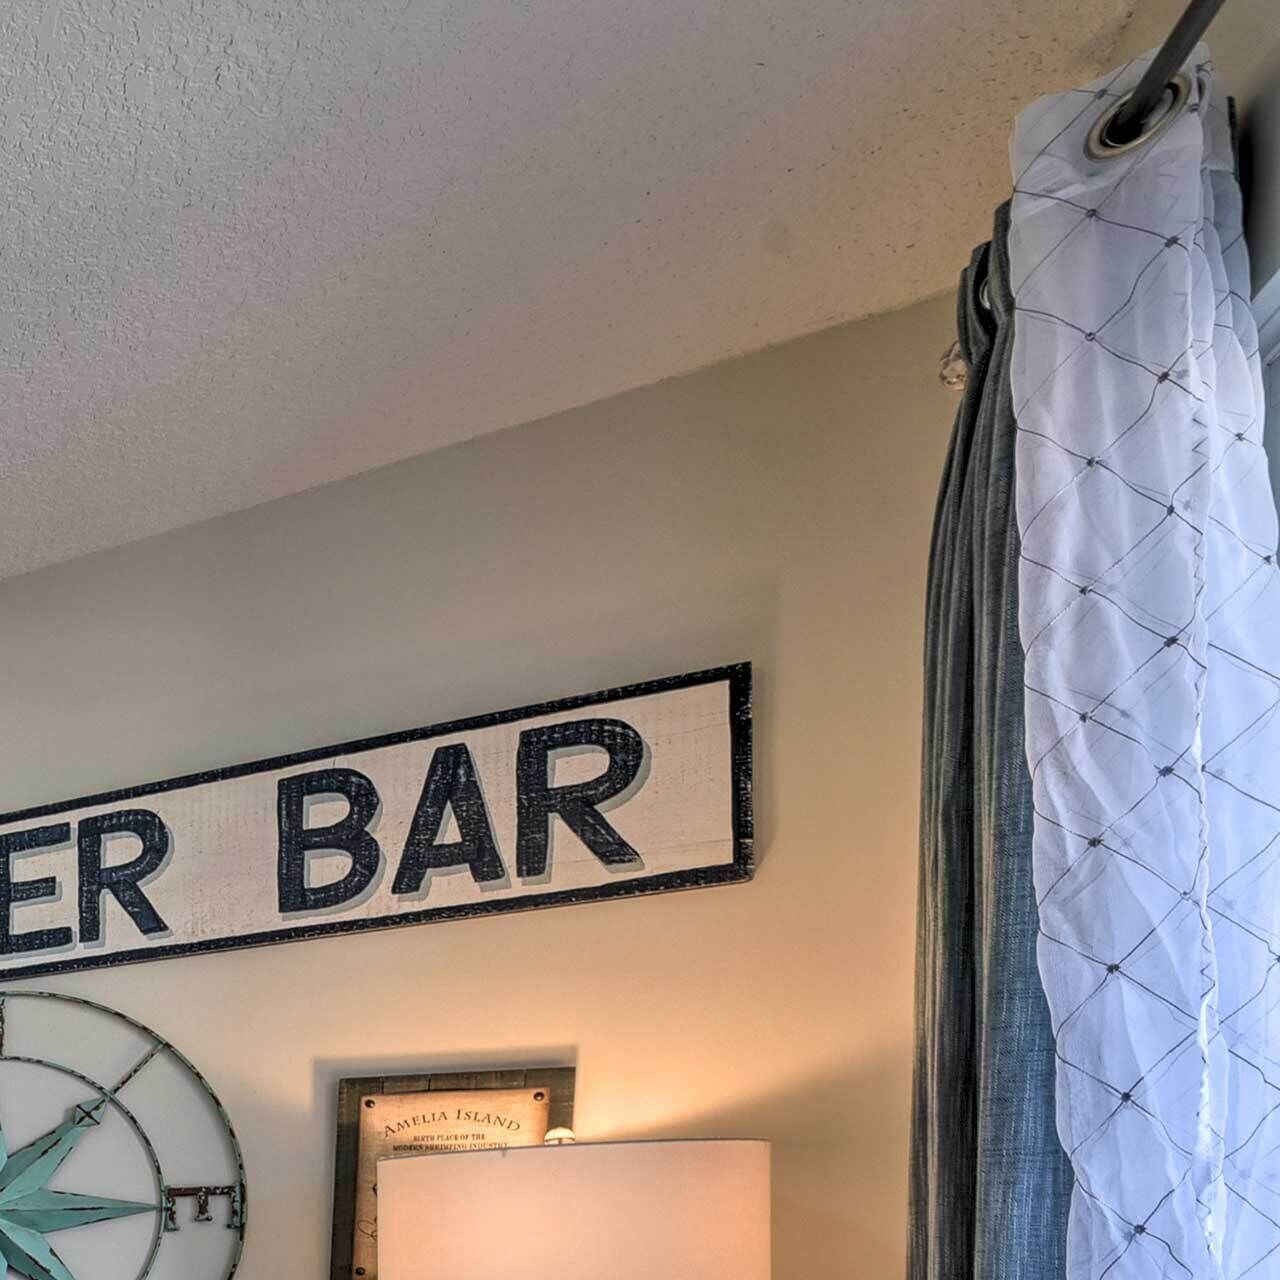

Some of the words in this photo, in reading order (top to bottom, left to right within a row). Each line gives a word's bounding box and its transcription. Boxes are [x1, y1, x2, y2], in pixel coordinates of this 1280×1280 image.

[276, 716, 648, 916] BAR
[384, 1110, 448, 1138] AMELIA
[456, 1109, 521, 1132] ISLAND
[414, 1134, 435, 1142] BIRTH
[437, 1134, 459, 1142] PLACE
[471, 1133, 486, 1141] THE
